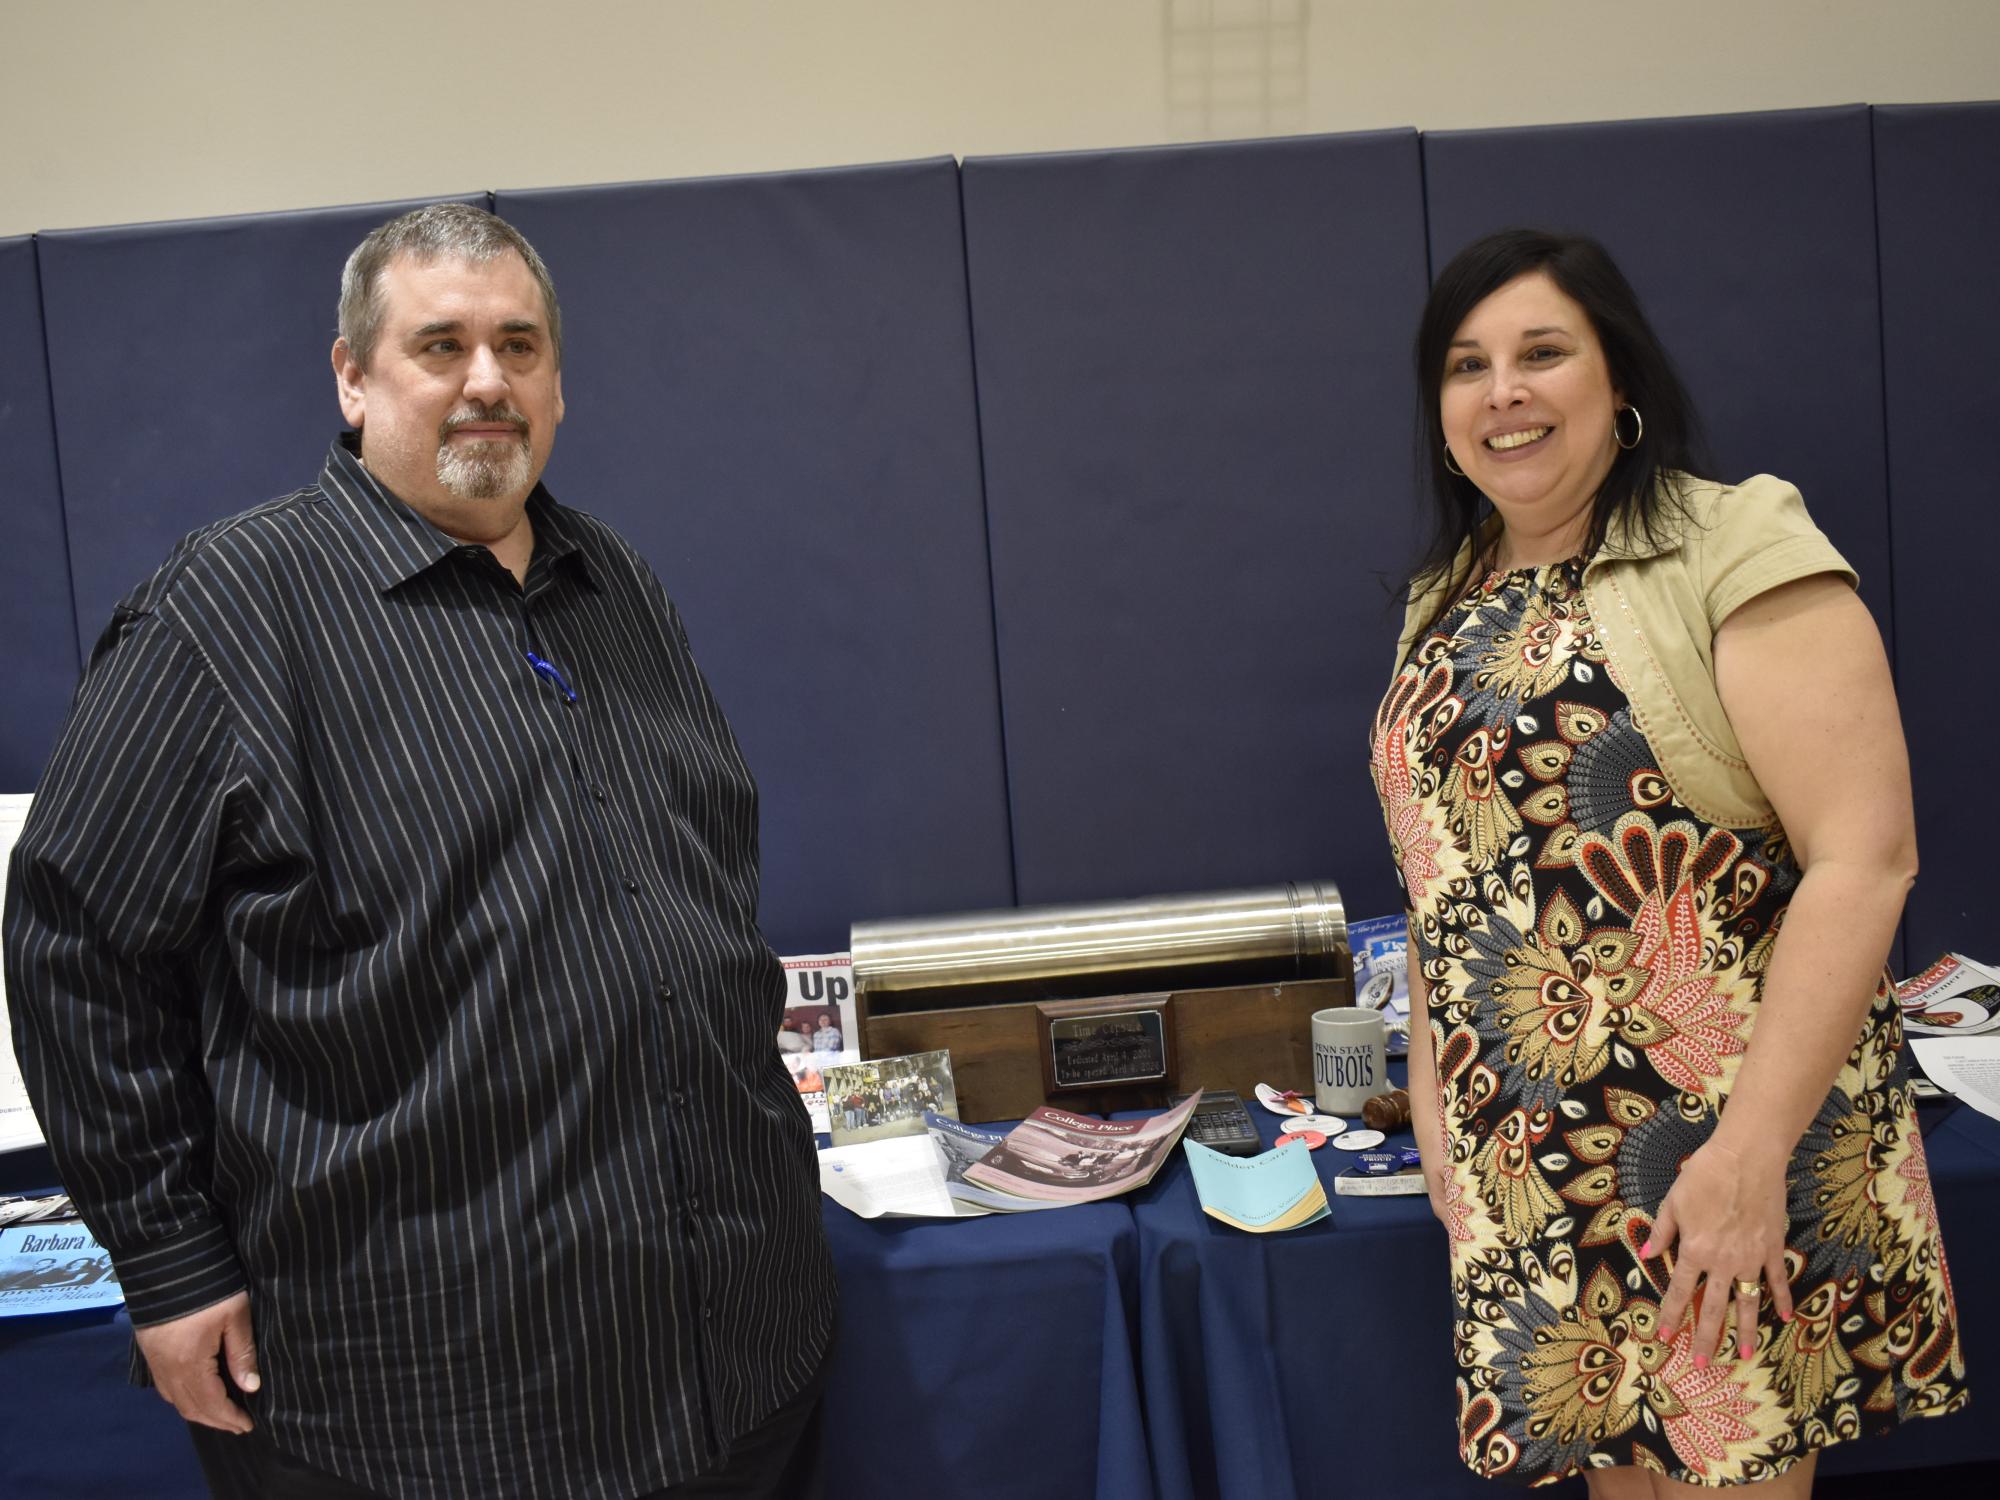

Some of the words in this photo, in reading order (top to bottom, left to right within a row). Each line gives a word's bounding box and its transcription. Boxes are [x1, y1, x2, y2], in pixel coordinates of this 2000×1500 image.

[799, 970, 849, 1006] Up
[1072, 1023, 1096, 1038] Time
[1315, 1042, 1337, 1055] PENN
[1339, 1044, 1374, 1055] STATE
[1316, 1052, 1374, 1088] DUBOIS
[936, 1117, 985, 1140] College
[1044, 1111, 1095, 1130] College
[1098, 1122, 1134, 1132] Place
[20, 1233, 85, 1253] Barbara
[1, 1284, 91, 1298] presents
